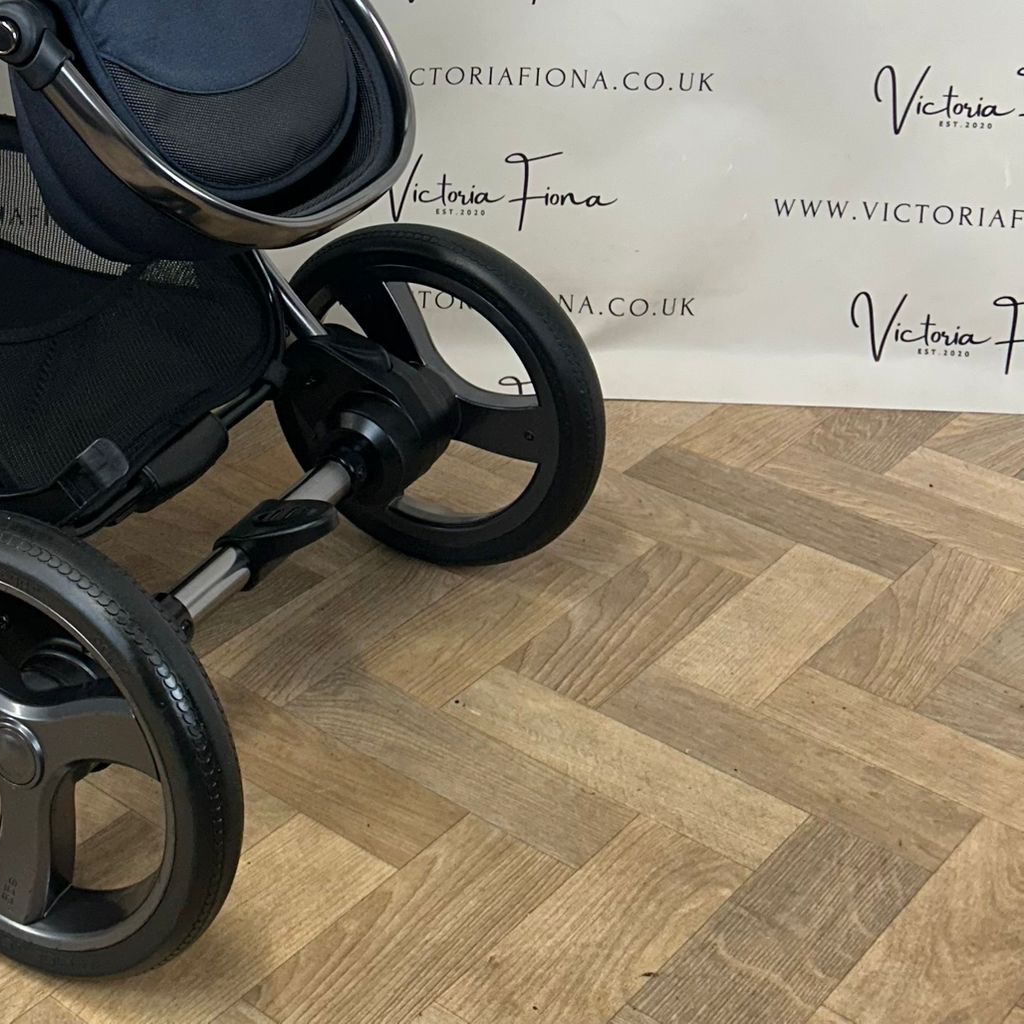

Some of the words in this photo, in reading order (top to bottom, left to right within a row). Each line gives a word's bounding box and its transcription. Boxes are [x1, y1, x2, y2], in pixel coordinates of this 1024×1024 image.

[874, 64, 1015, 136] Victoria
[939, 120, 993, 130] EST.2020
[505, 152, 618, 231] Fiona
[435, 208, 486, 217] EST.2020
[851, 291, 991, 362] Victoria
[917, 348, 970, 357] EST.2020
